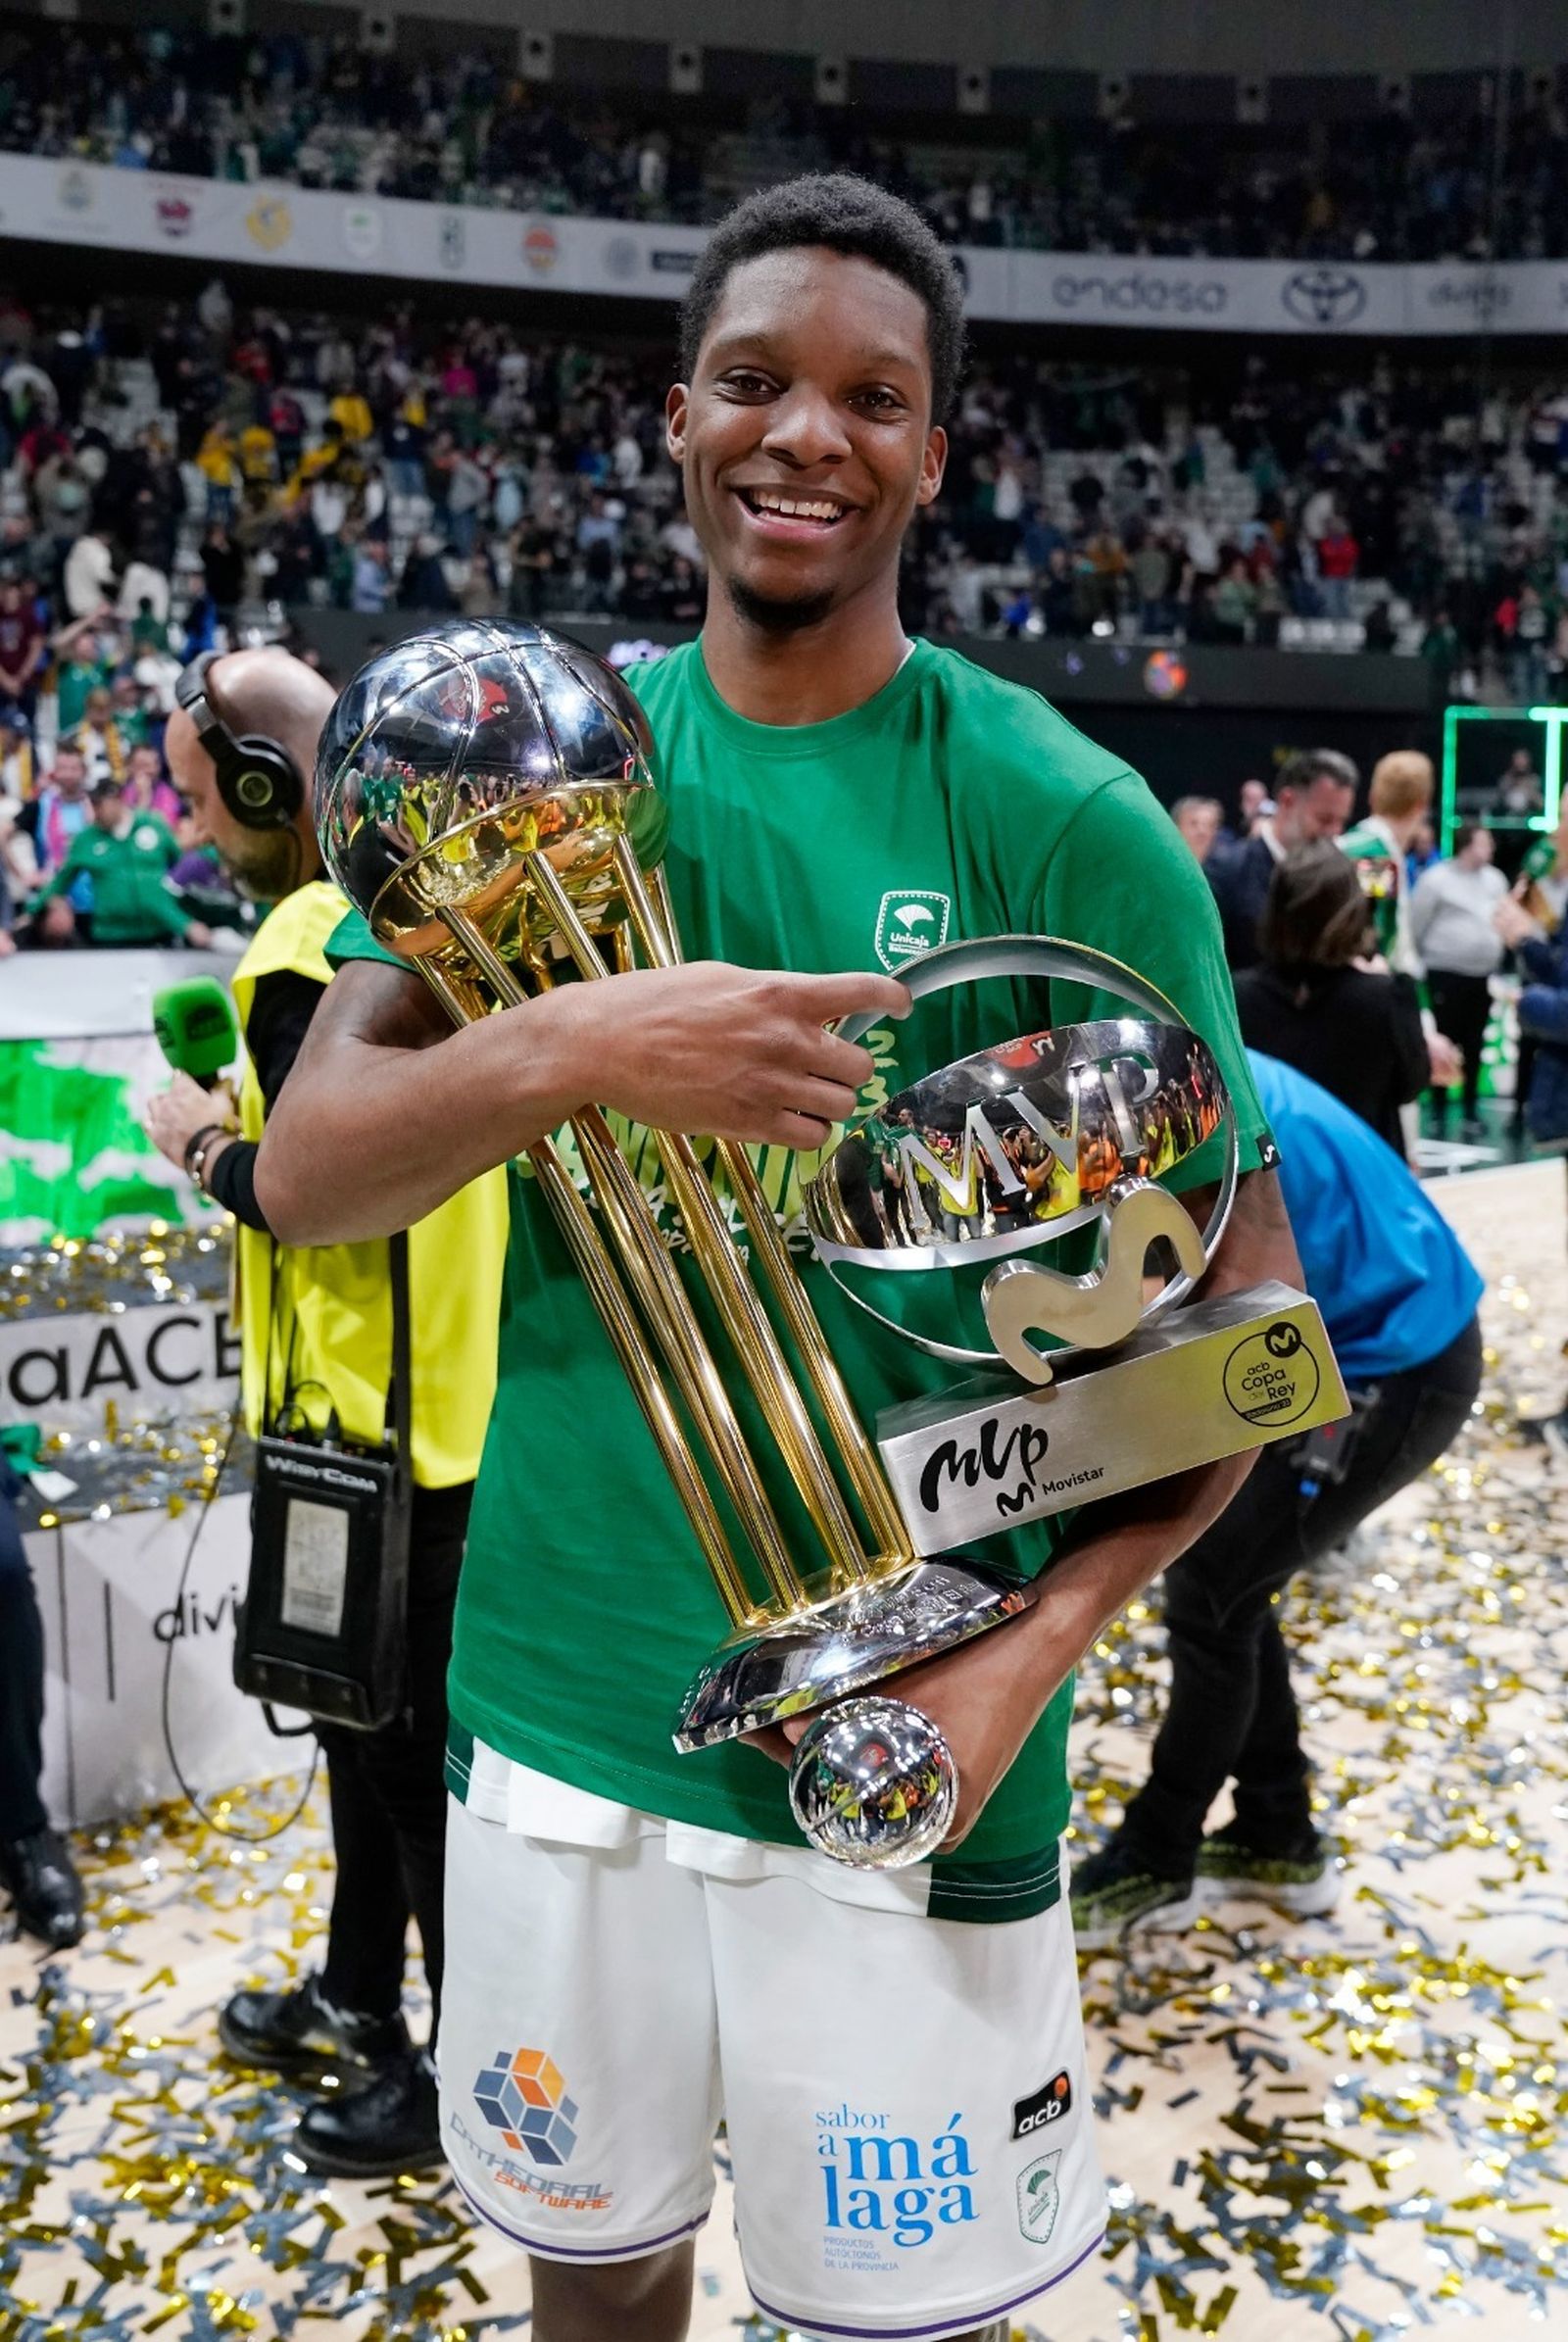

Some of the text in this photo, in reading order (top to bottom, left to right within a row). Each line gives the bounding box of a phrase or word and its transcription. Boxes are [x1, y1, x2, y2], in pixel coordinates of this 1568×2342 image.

[1053, 269, 1228, 314] endesa
[890, 932, 930, 949] Unicaja
[897, 1050, 1160, 1227] MVP
[1242, 1369, 1286, 1391] Copa
[1247, 1362, 1270, 1376] acb
[1267, 1382, 1296, 1400] Rey
[1042, 1467, 1104, 1495] Movistar
[815, 2104, 891, 2129] sabor
[1018, 2099, 1061, 2134] acb
[817, 2113, 979, 2181] a má
[820, 2166, 981, 2248] laga
[823, 2236, 875, 2249] PRODUCTOS
[824, 2258, 899, 2271] DE LA PROVINCIA
